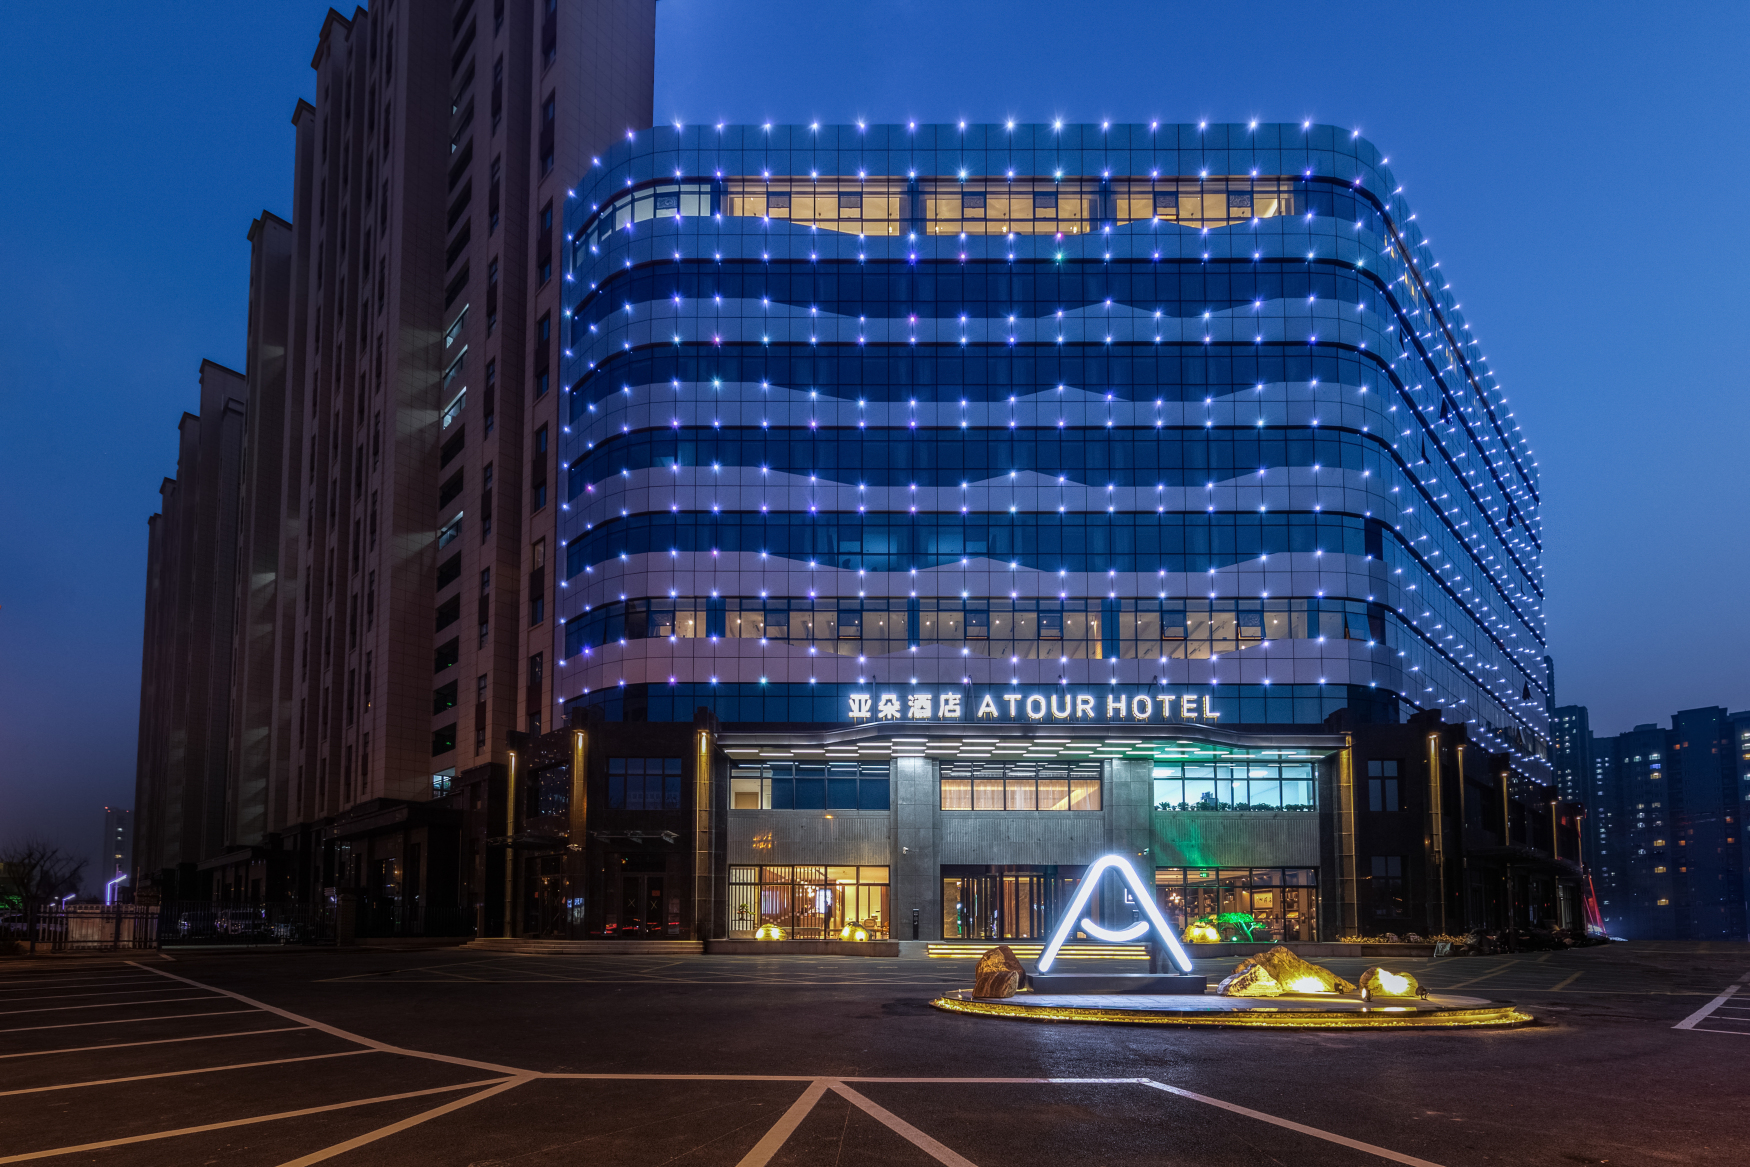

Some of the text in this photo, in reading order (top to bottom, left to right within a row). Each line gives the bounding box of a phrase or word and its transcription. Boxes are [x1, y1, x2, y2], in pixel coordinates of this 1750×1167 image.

[848, 692, 1221, 720] 亚朵酒店 ATOUR HOTEL
